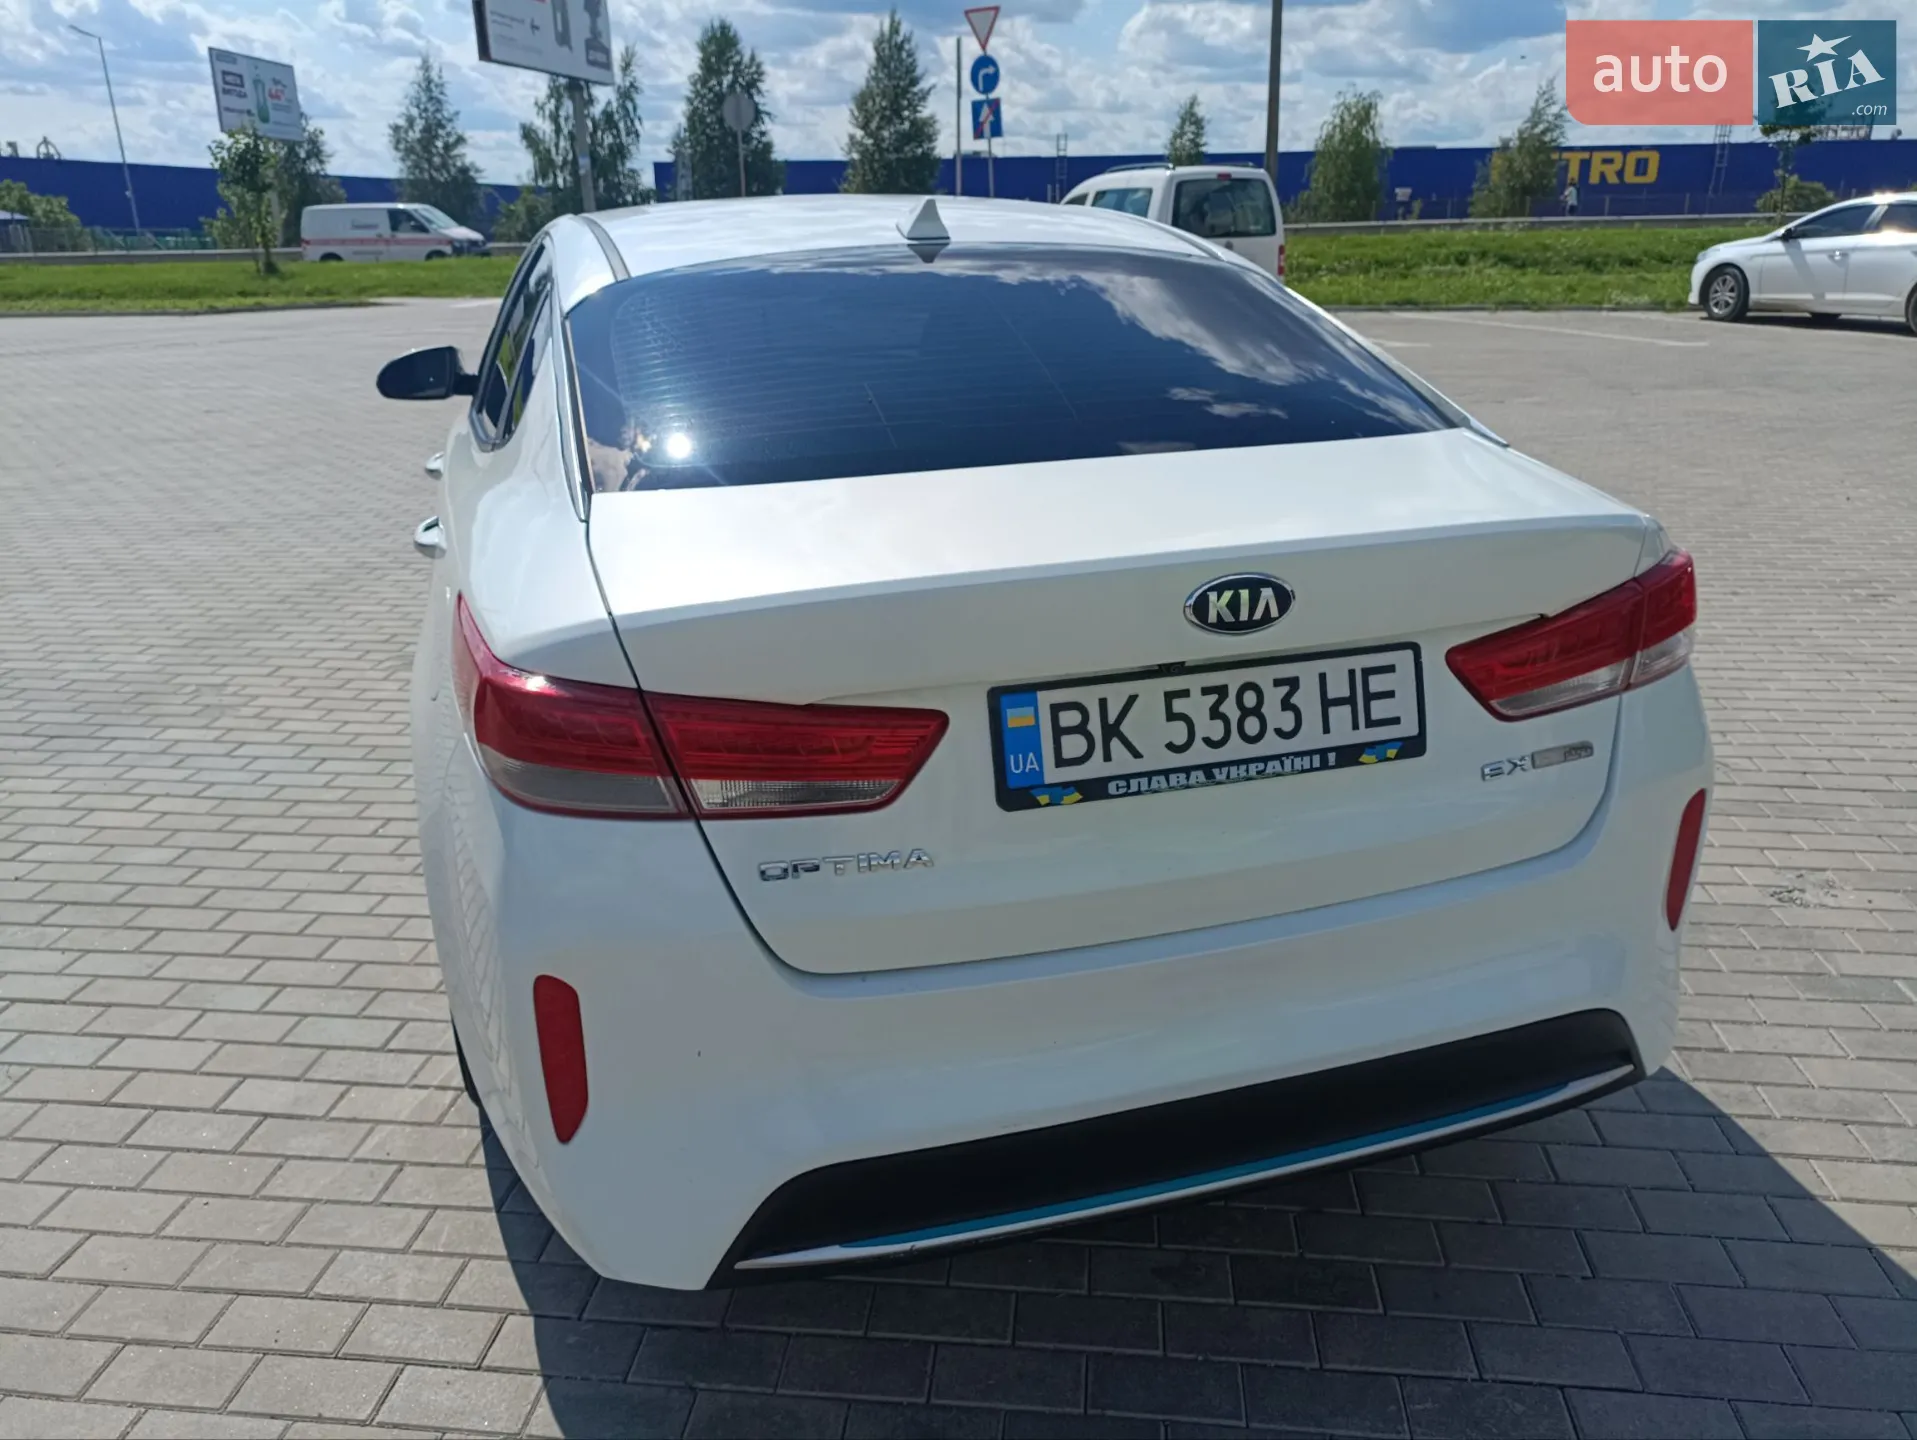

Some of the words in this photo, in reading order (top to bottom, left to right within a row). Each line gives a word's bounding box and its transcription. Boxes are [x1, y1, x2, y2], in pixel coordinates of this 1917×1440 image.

[1207, 587, 1279, 623] KIA
[1049, 693, 1144, 768] BK
[1163, 676, 1302, 754] 5383
[1318, 664, 1401, 735] HE
[1010, 752, 1040, 775] UA
[1480, 755, 1531, 782] EX
[1108, 770, 1205, 795] СЛАВА
[758, 848, 934, 881] OPTIMA
